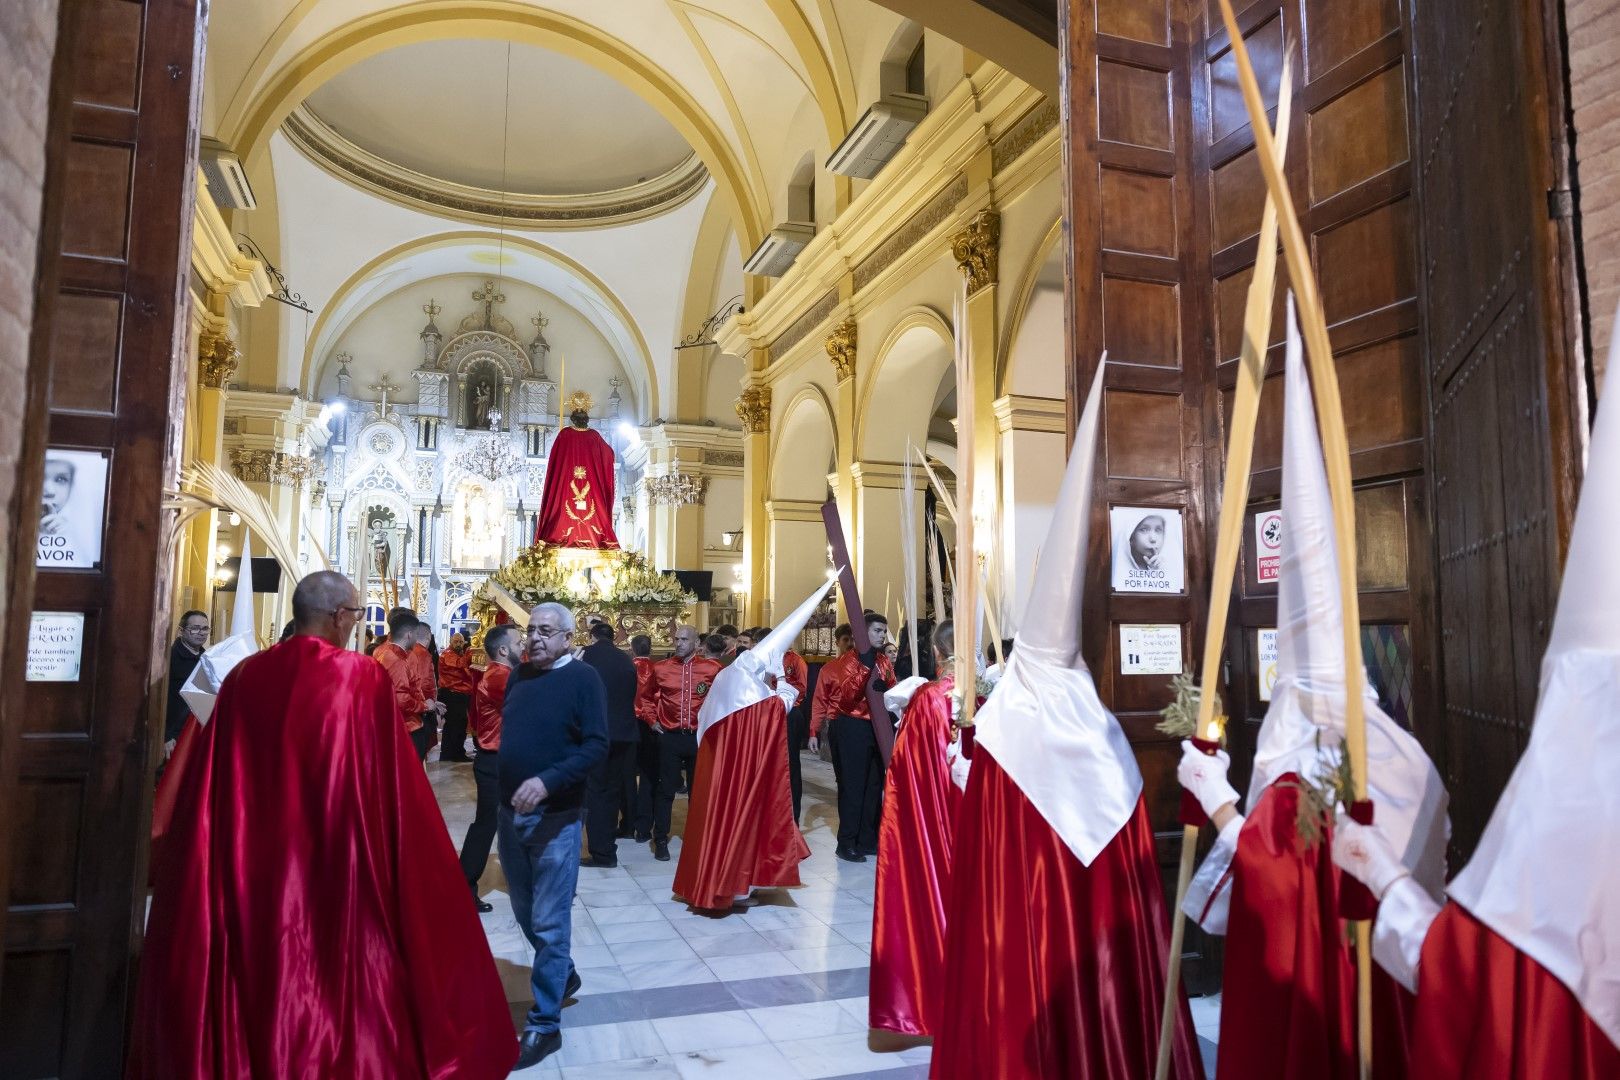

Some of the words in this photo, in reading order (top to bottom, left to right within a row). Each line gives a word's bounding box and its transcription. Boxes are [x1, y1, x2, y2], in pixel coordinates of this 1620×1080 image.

[1128, 570, 1165, 579] SILENCIO
[1124, 580, 1142, 588] POR
[1143, 580, 1170, 589] FAVOR
